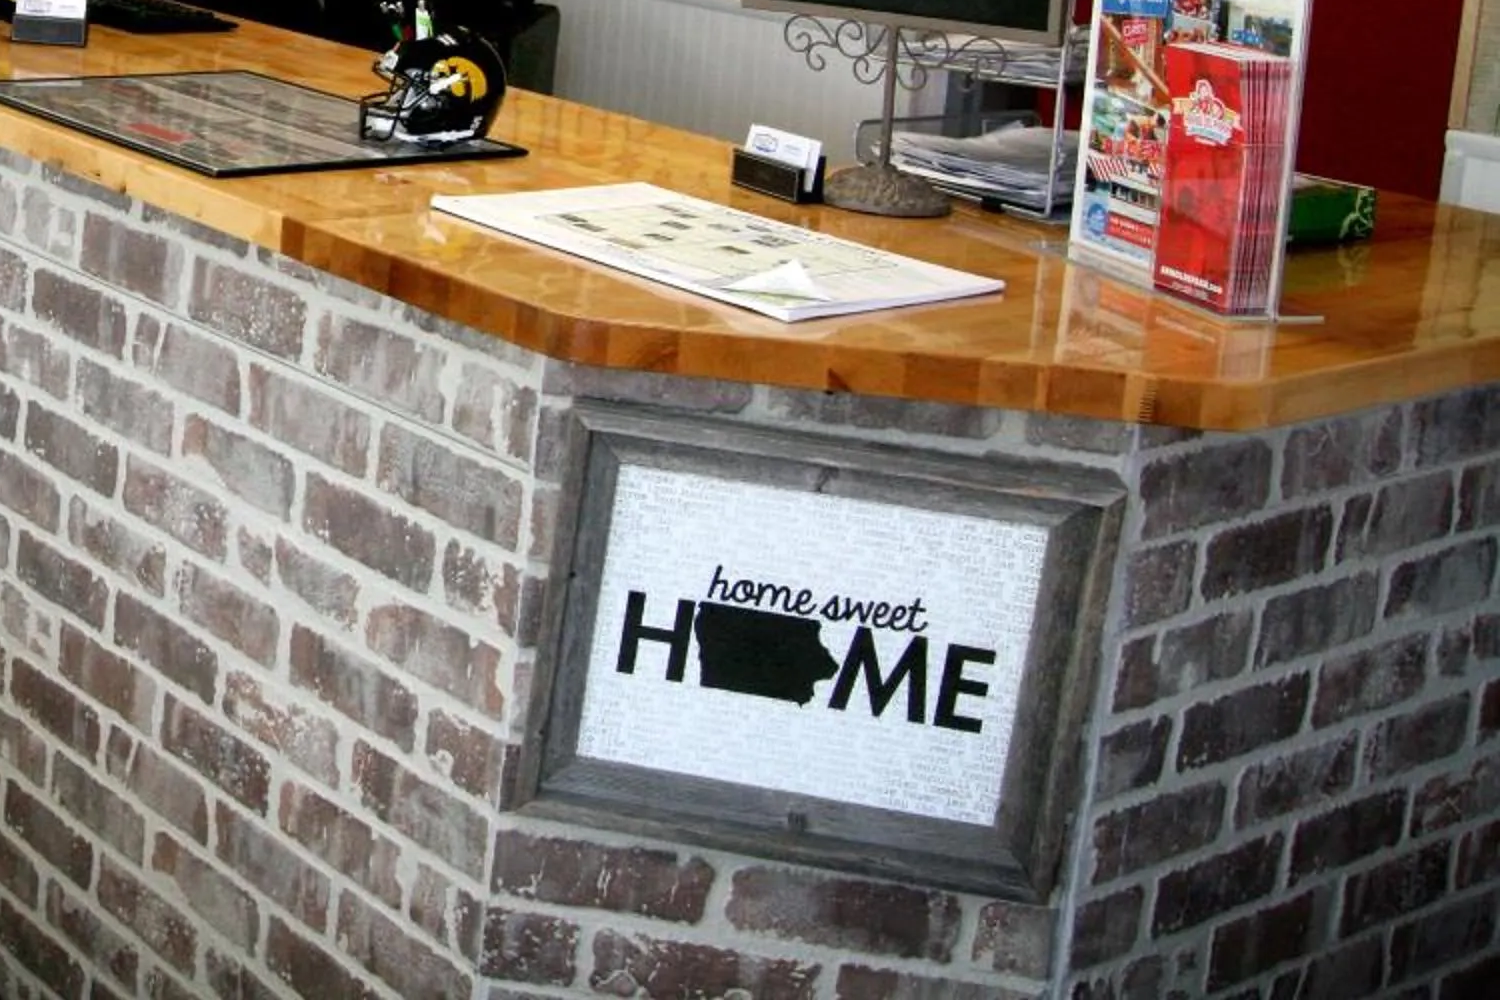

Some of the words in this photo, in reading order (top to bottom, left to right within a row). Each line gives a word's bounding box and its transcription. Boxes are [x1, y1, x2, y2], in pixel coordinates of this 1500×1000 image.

[707, 564, 817, 617] home
[819, 596, 929, 633] sweet
[615, 590, 997, 734] HME
